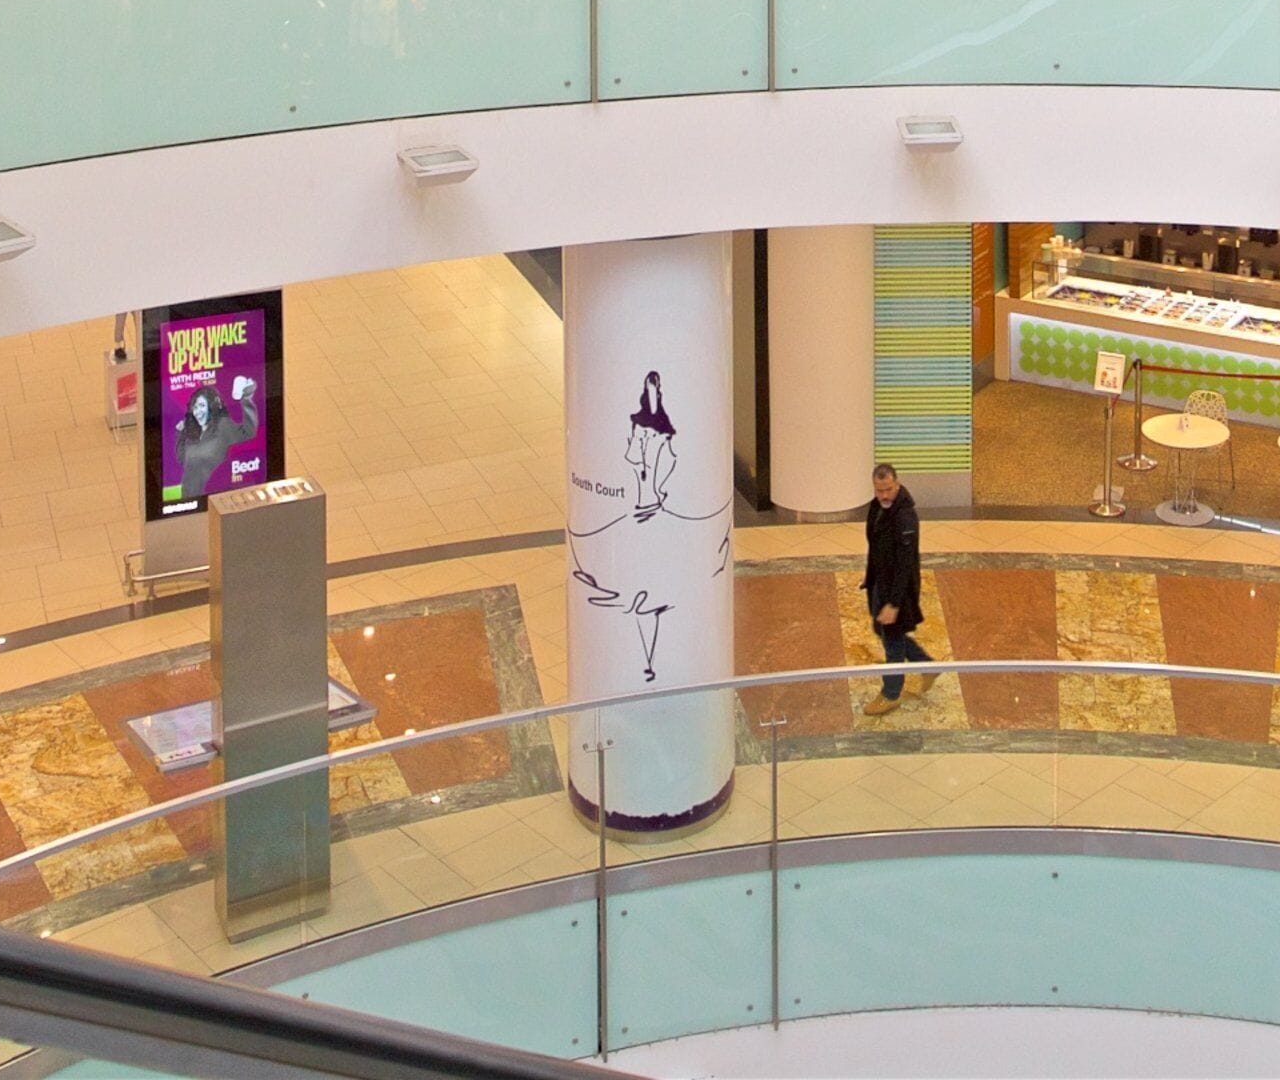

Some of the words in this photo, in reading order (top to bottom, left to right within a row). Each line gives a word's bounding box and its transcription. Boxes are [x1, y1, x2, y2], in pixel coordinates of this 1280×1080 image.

[167, 327, 205, 355] YOUR
[206, 321, 247, 348] WAKE
[168, 346, 188, 374] UP
[189, 344, 224, 371] CALL
[170, 374, 192, 384] WITH
[231, 457, 260, 474] Beat
[595, 482, 625, 498] Court
